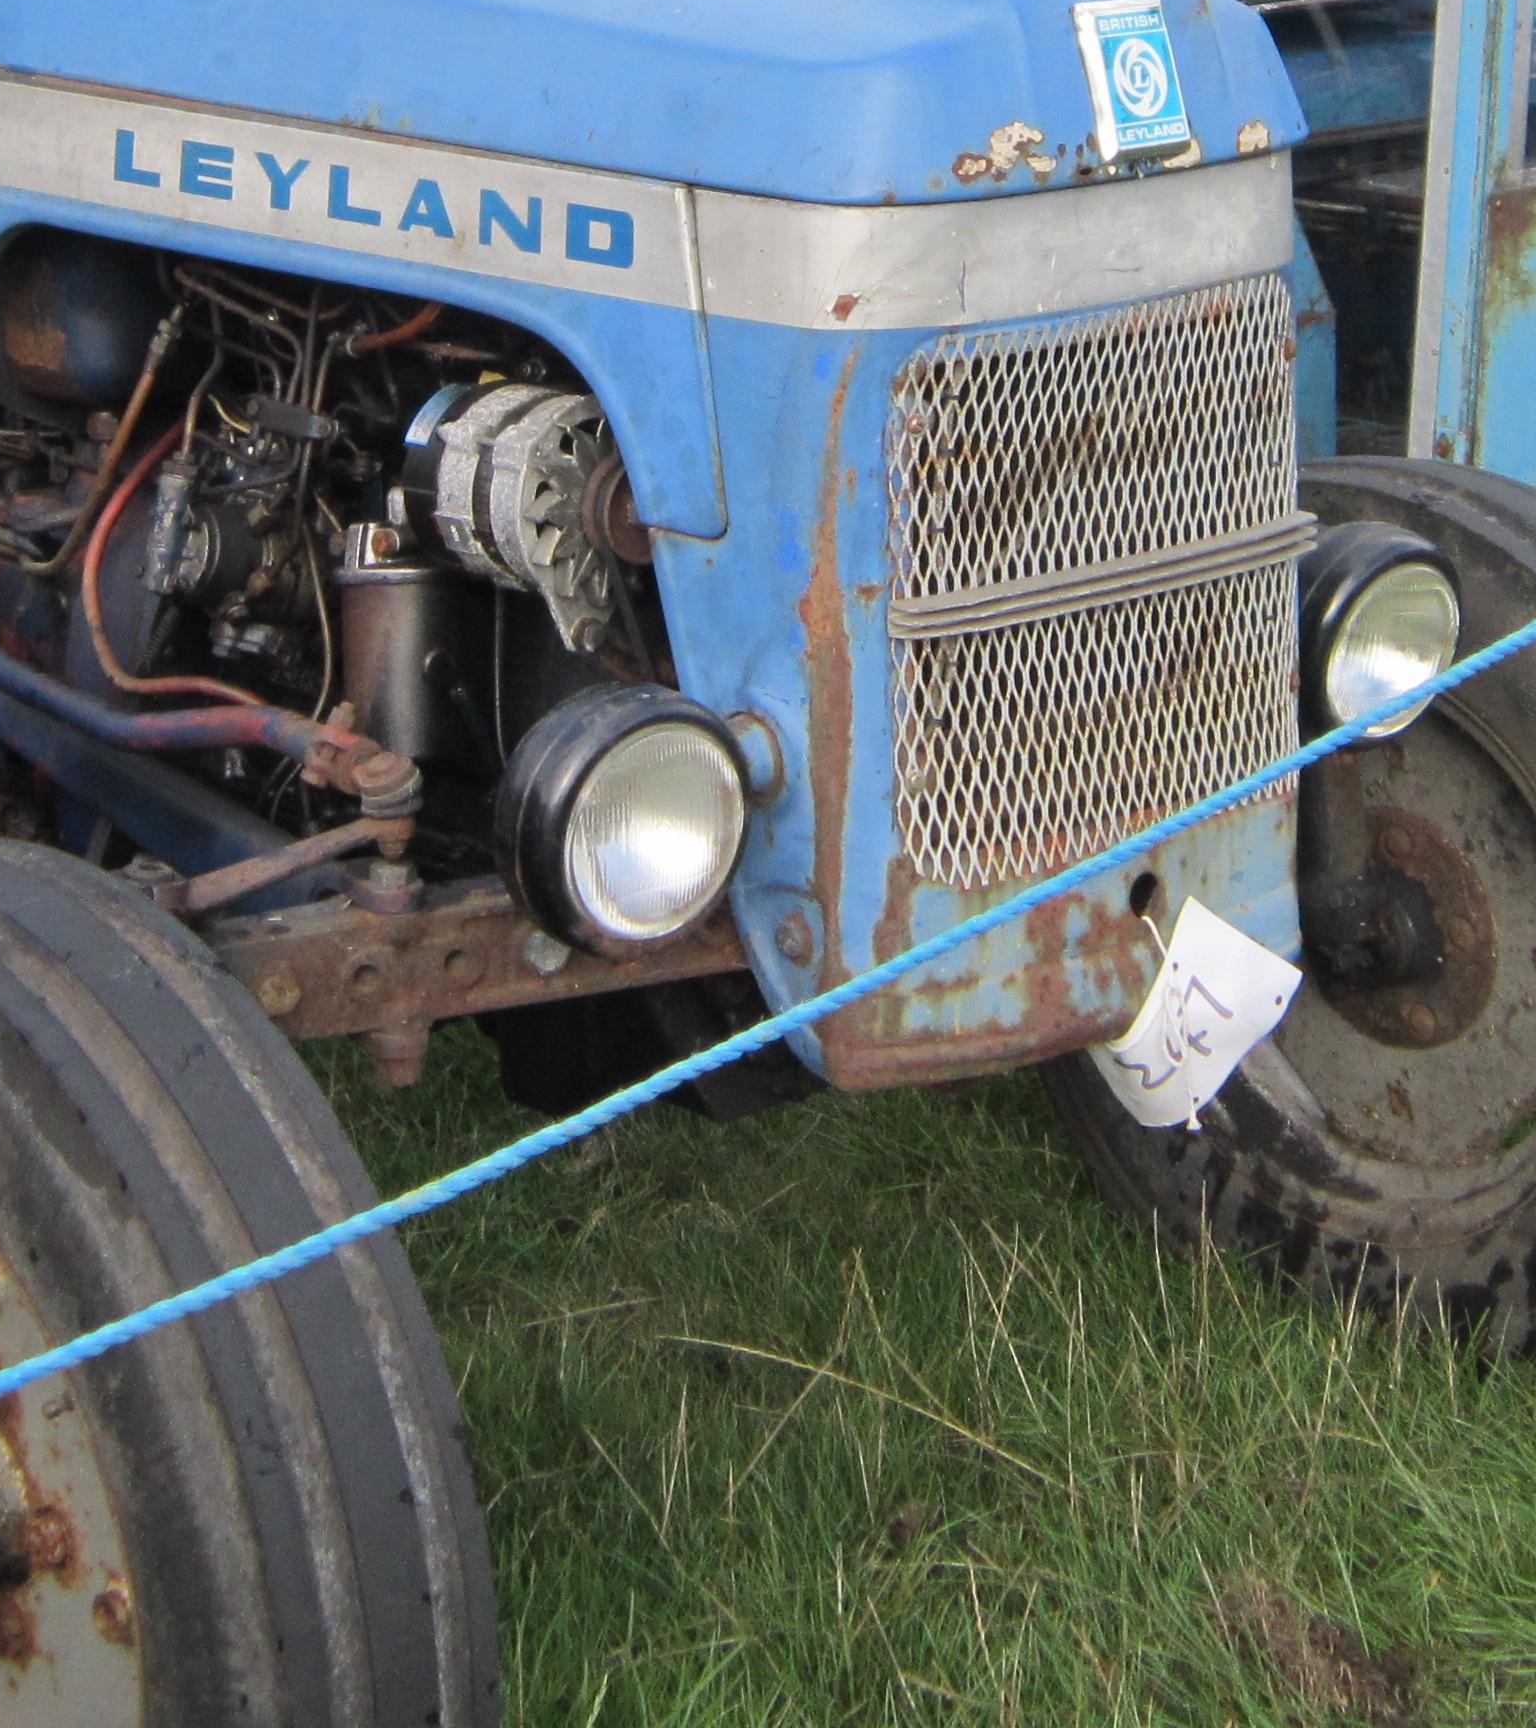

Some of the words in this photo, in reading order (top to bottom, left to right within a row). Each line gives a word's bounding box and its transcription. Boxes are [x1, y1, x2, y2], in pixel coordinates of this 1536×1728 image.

[1098, 14, 1159, 32] BRITISH
[1118, 122, 1186, 143] LEYLAND
[114, 128, 634, 269] LEYLAND
